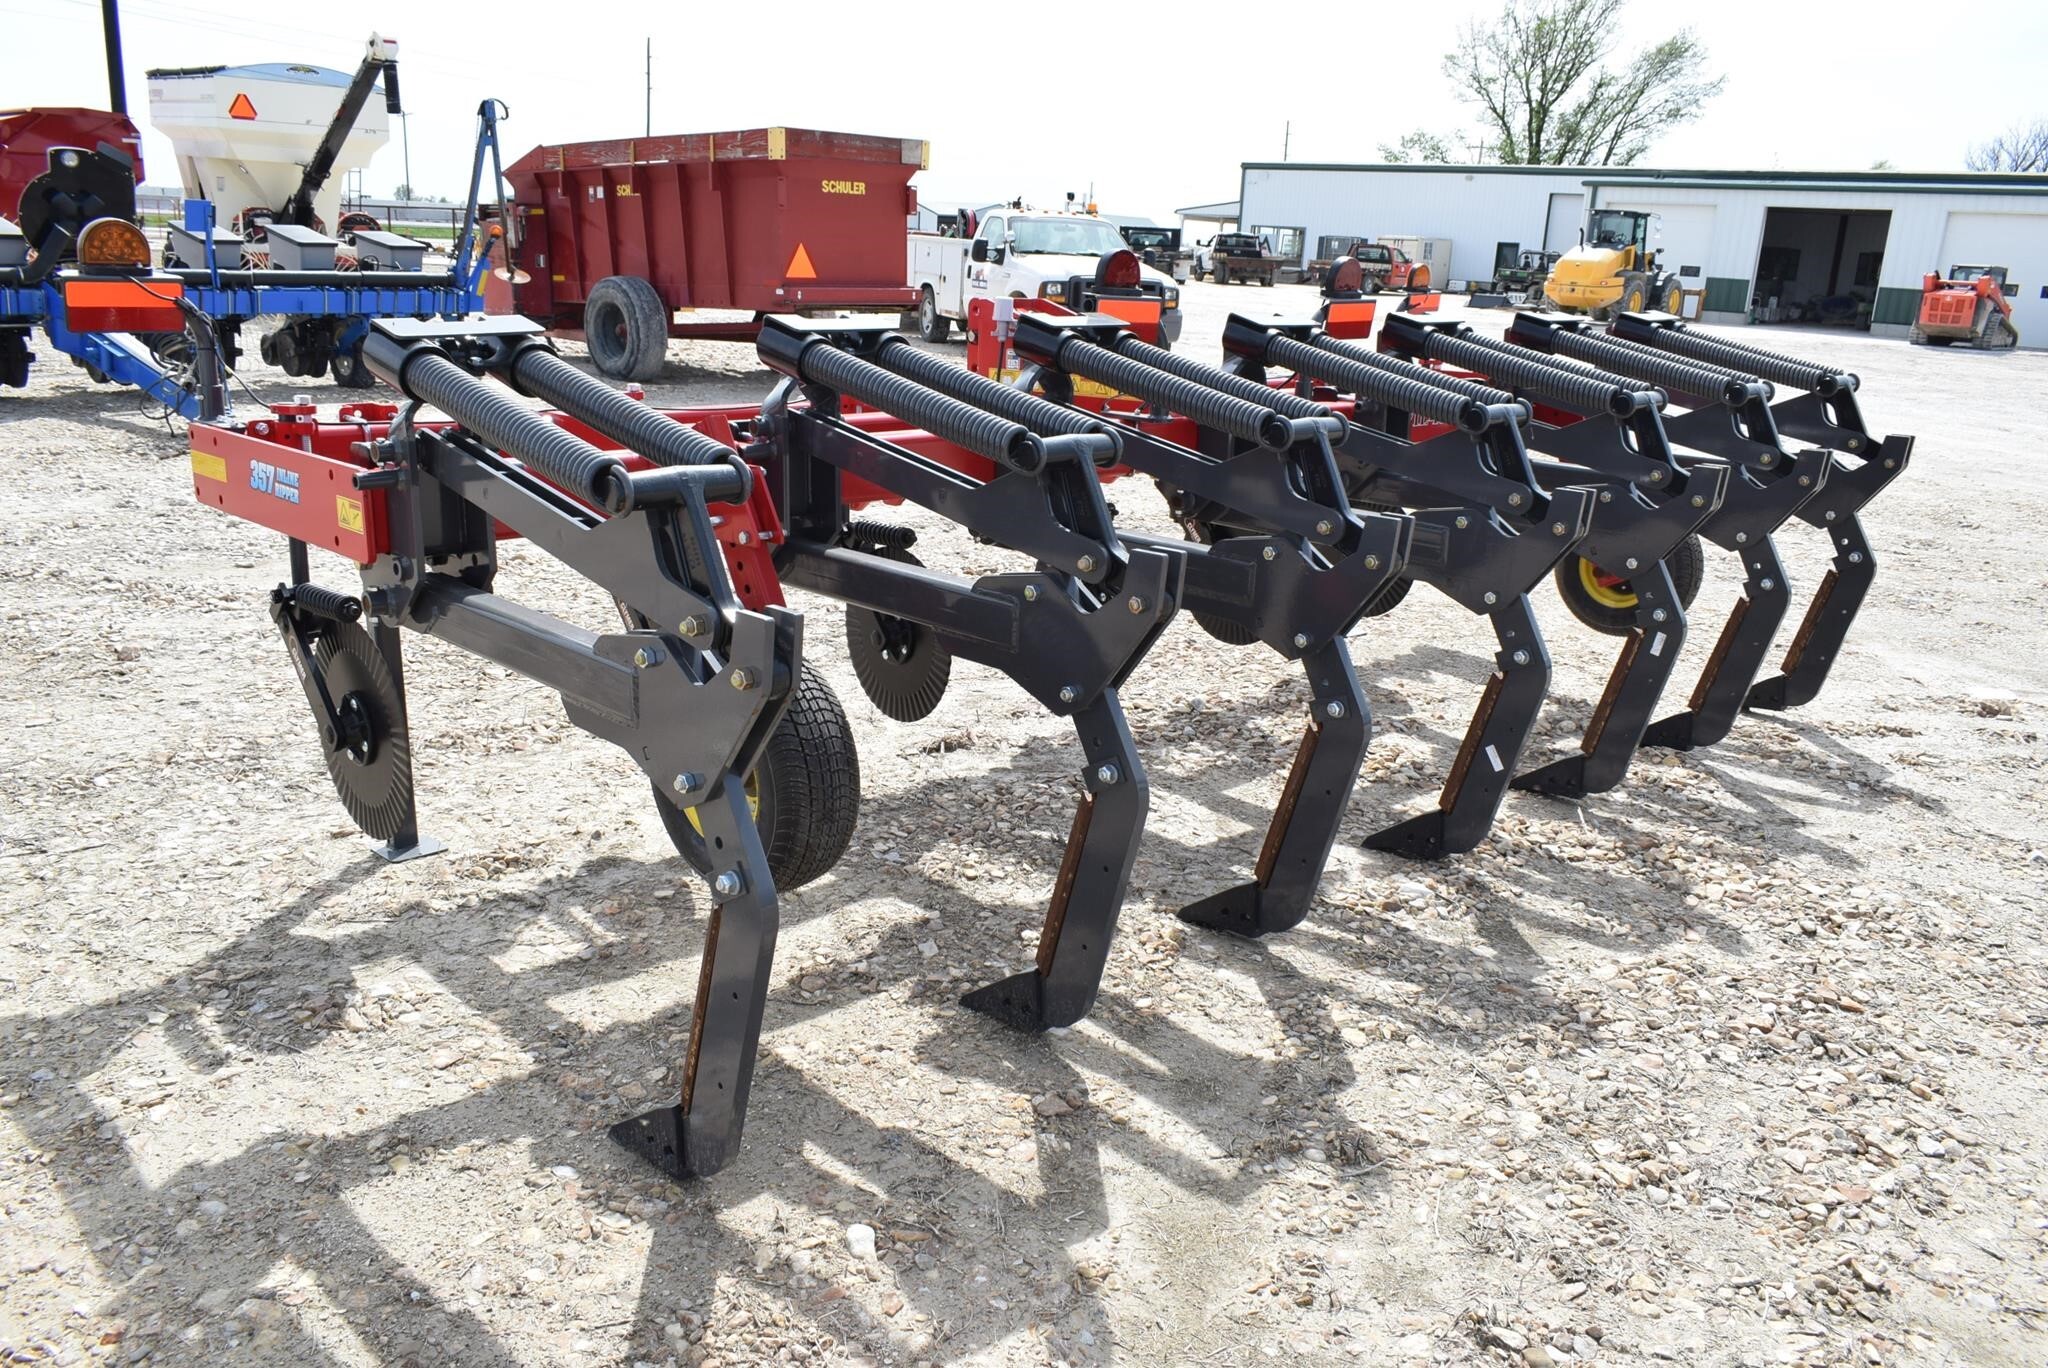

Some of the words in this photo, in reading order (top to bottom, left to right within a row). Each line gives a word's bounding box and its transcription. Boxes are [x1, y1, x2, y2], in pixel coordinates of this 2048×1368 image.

[616, 184, 640, 197] SCH
[821, 180, 866, 195] SCHULER
[250, 459, 274, 494] 357
[275, 482, 299, 504] RIPPER
